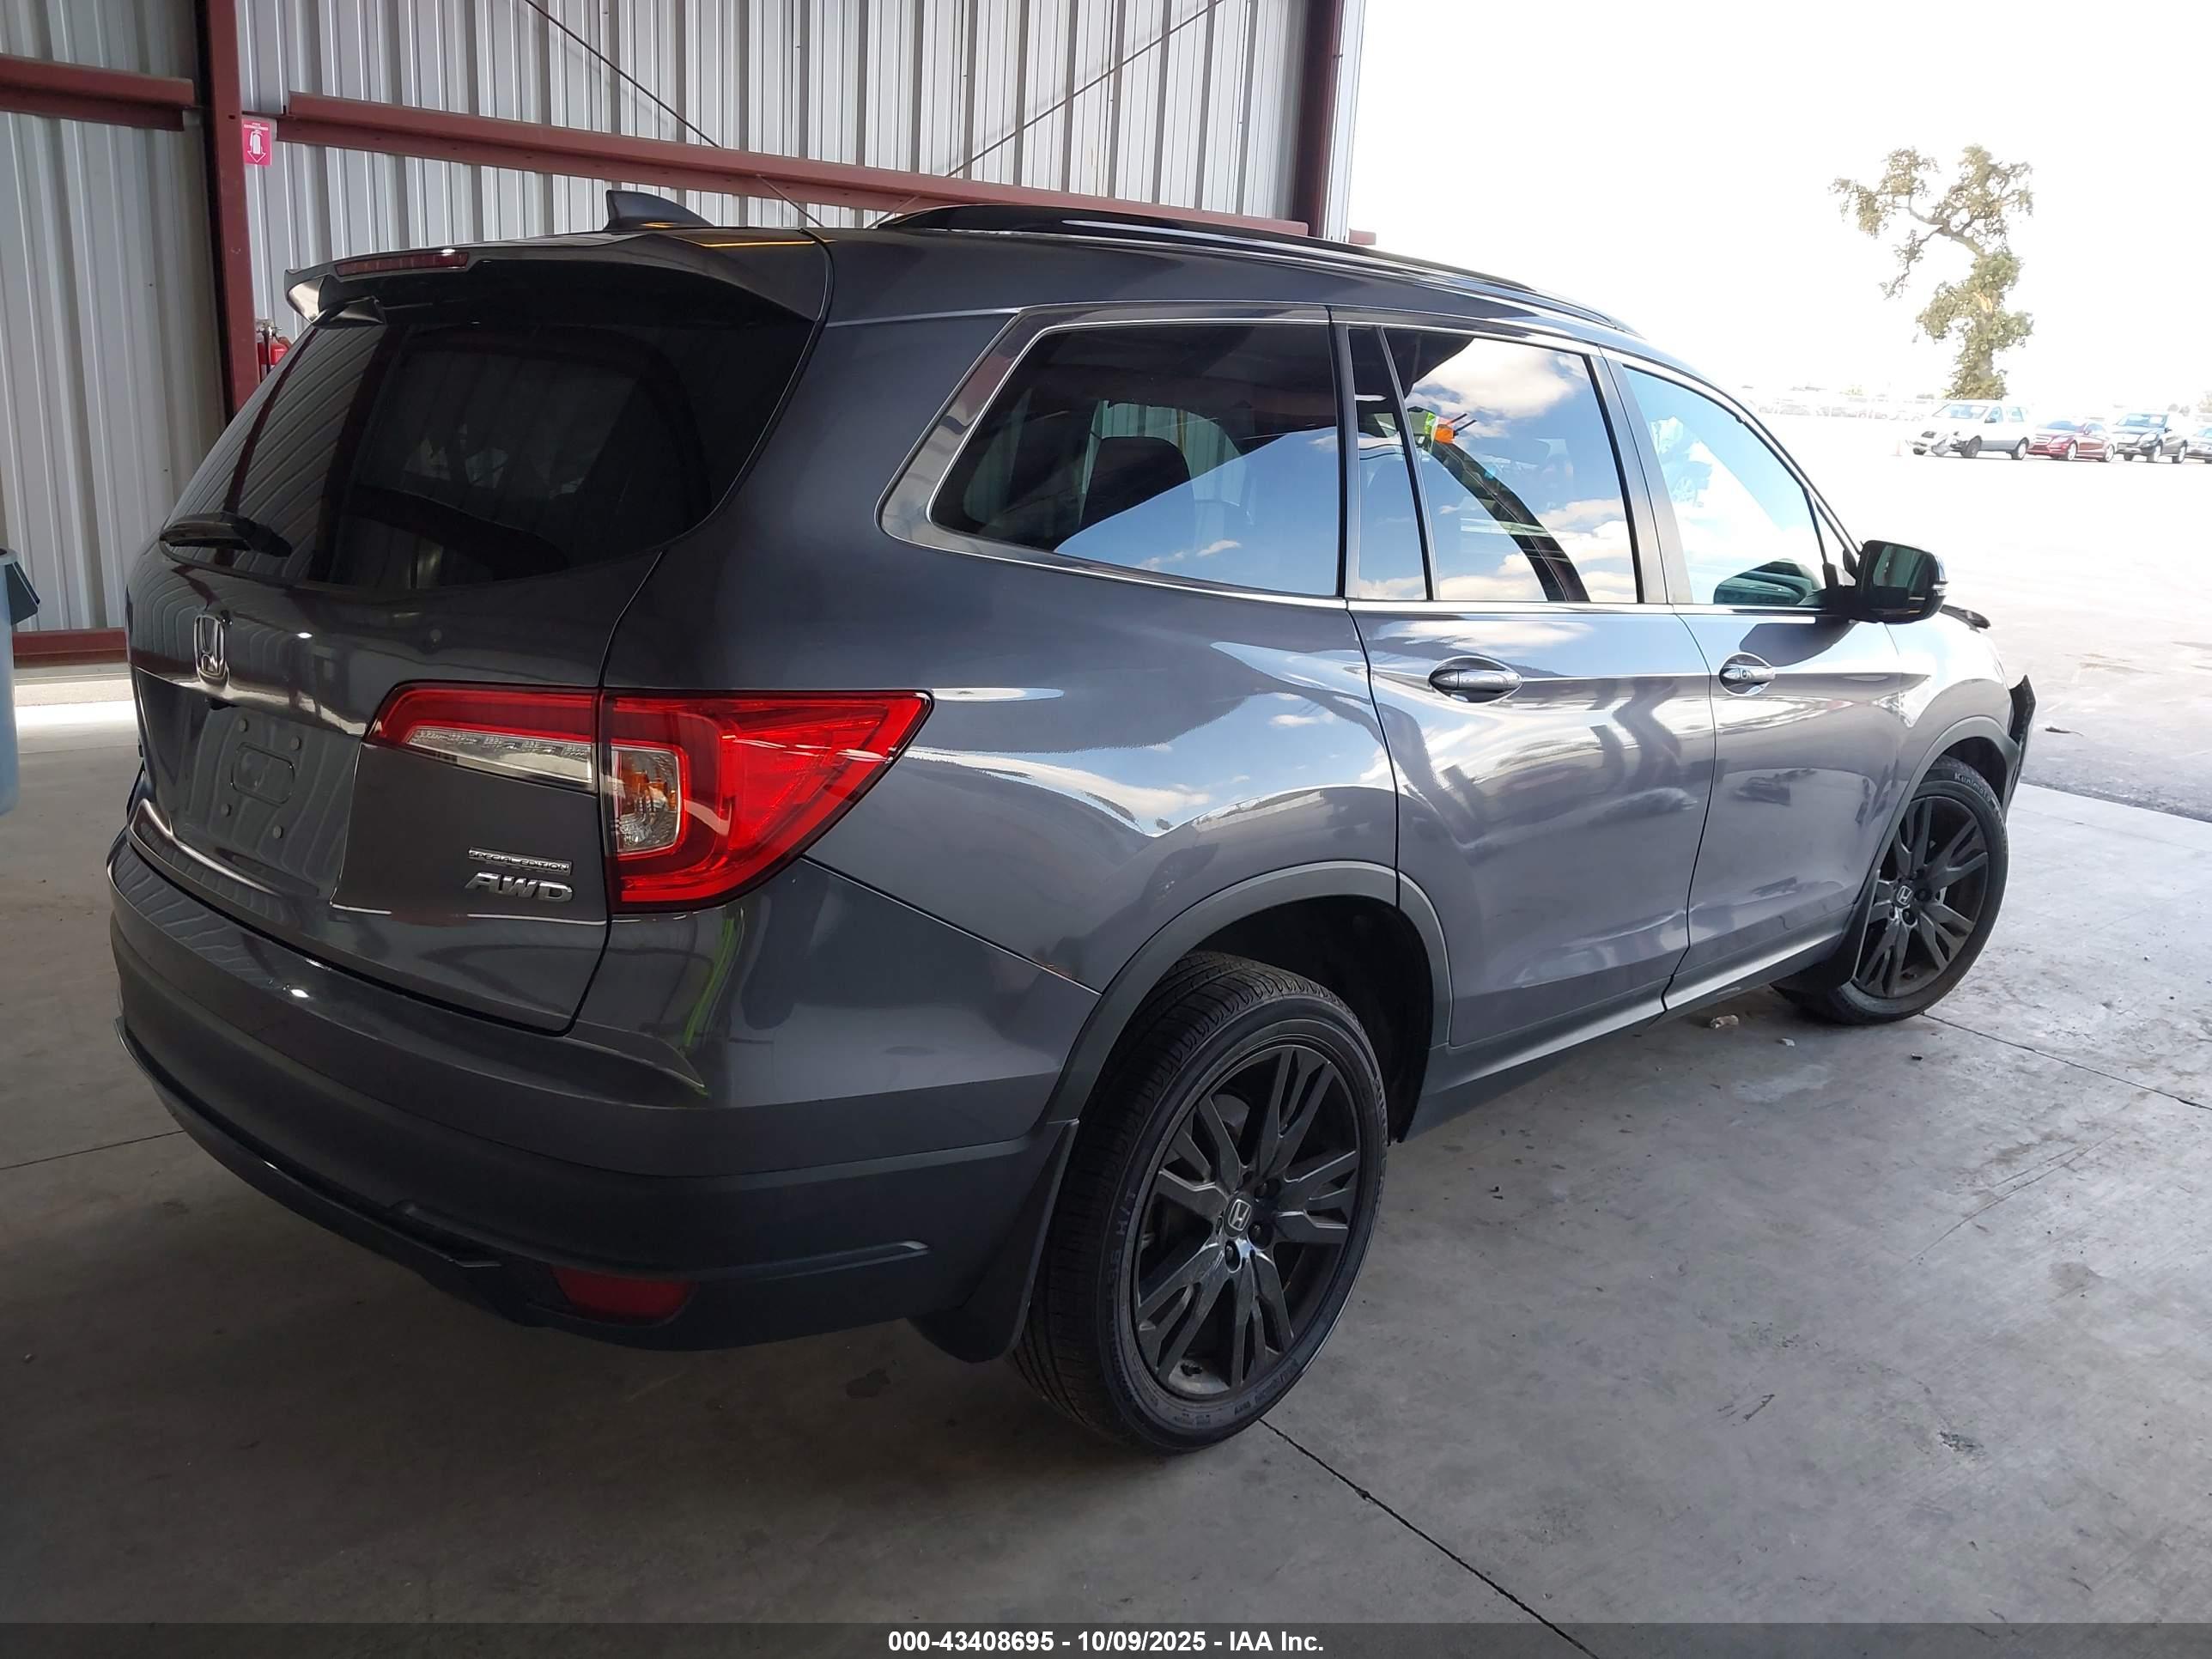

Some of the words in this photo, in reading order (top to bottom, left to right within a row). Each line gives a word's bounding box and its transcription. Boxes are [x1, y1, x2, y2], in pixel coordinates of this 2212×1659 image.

[469, 850, 517, 865] SPECIAL
[519, 859, 569, 872] EDITION
[465, 872, 573, 902] AWD
